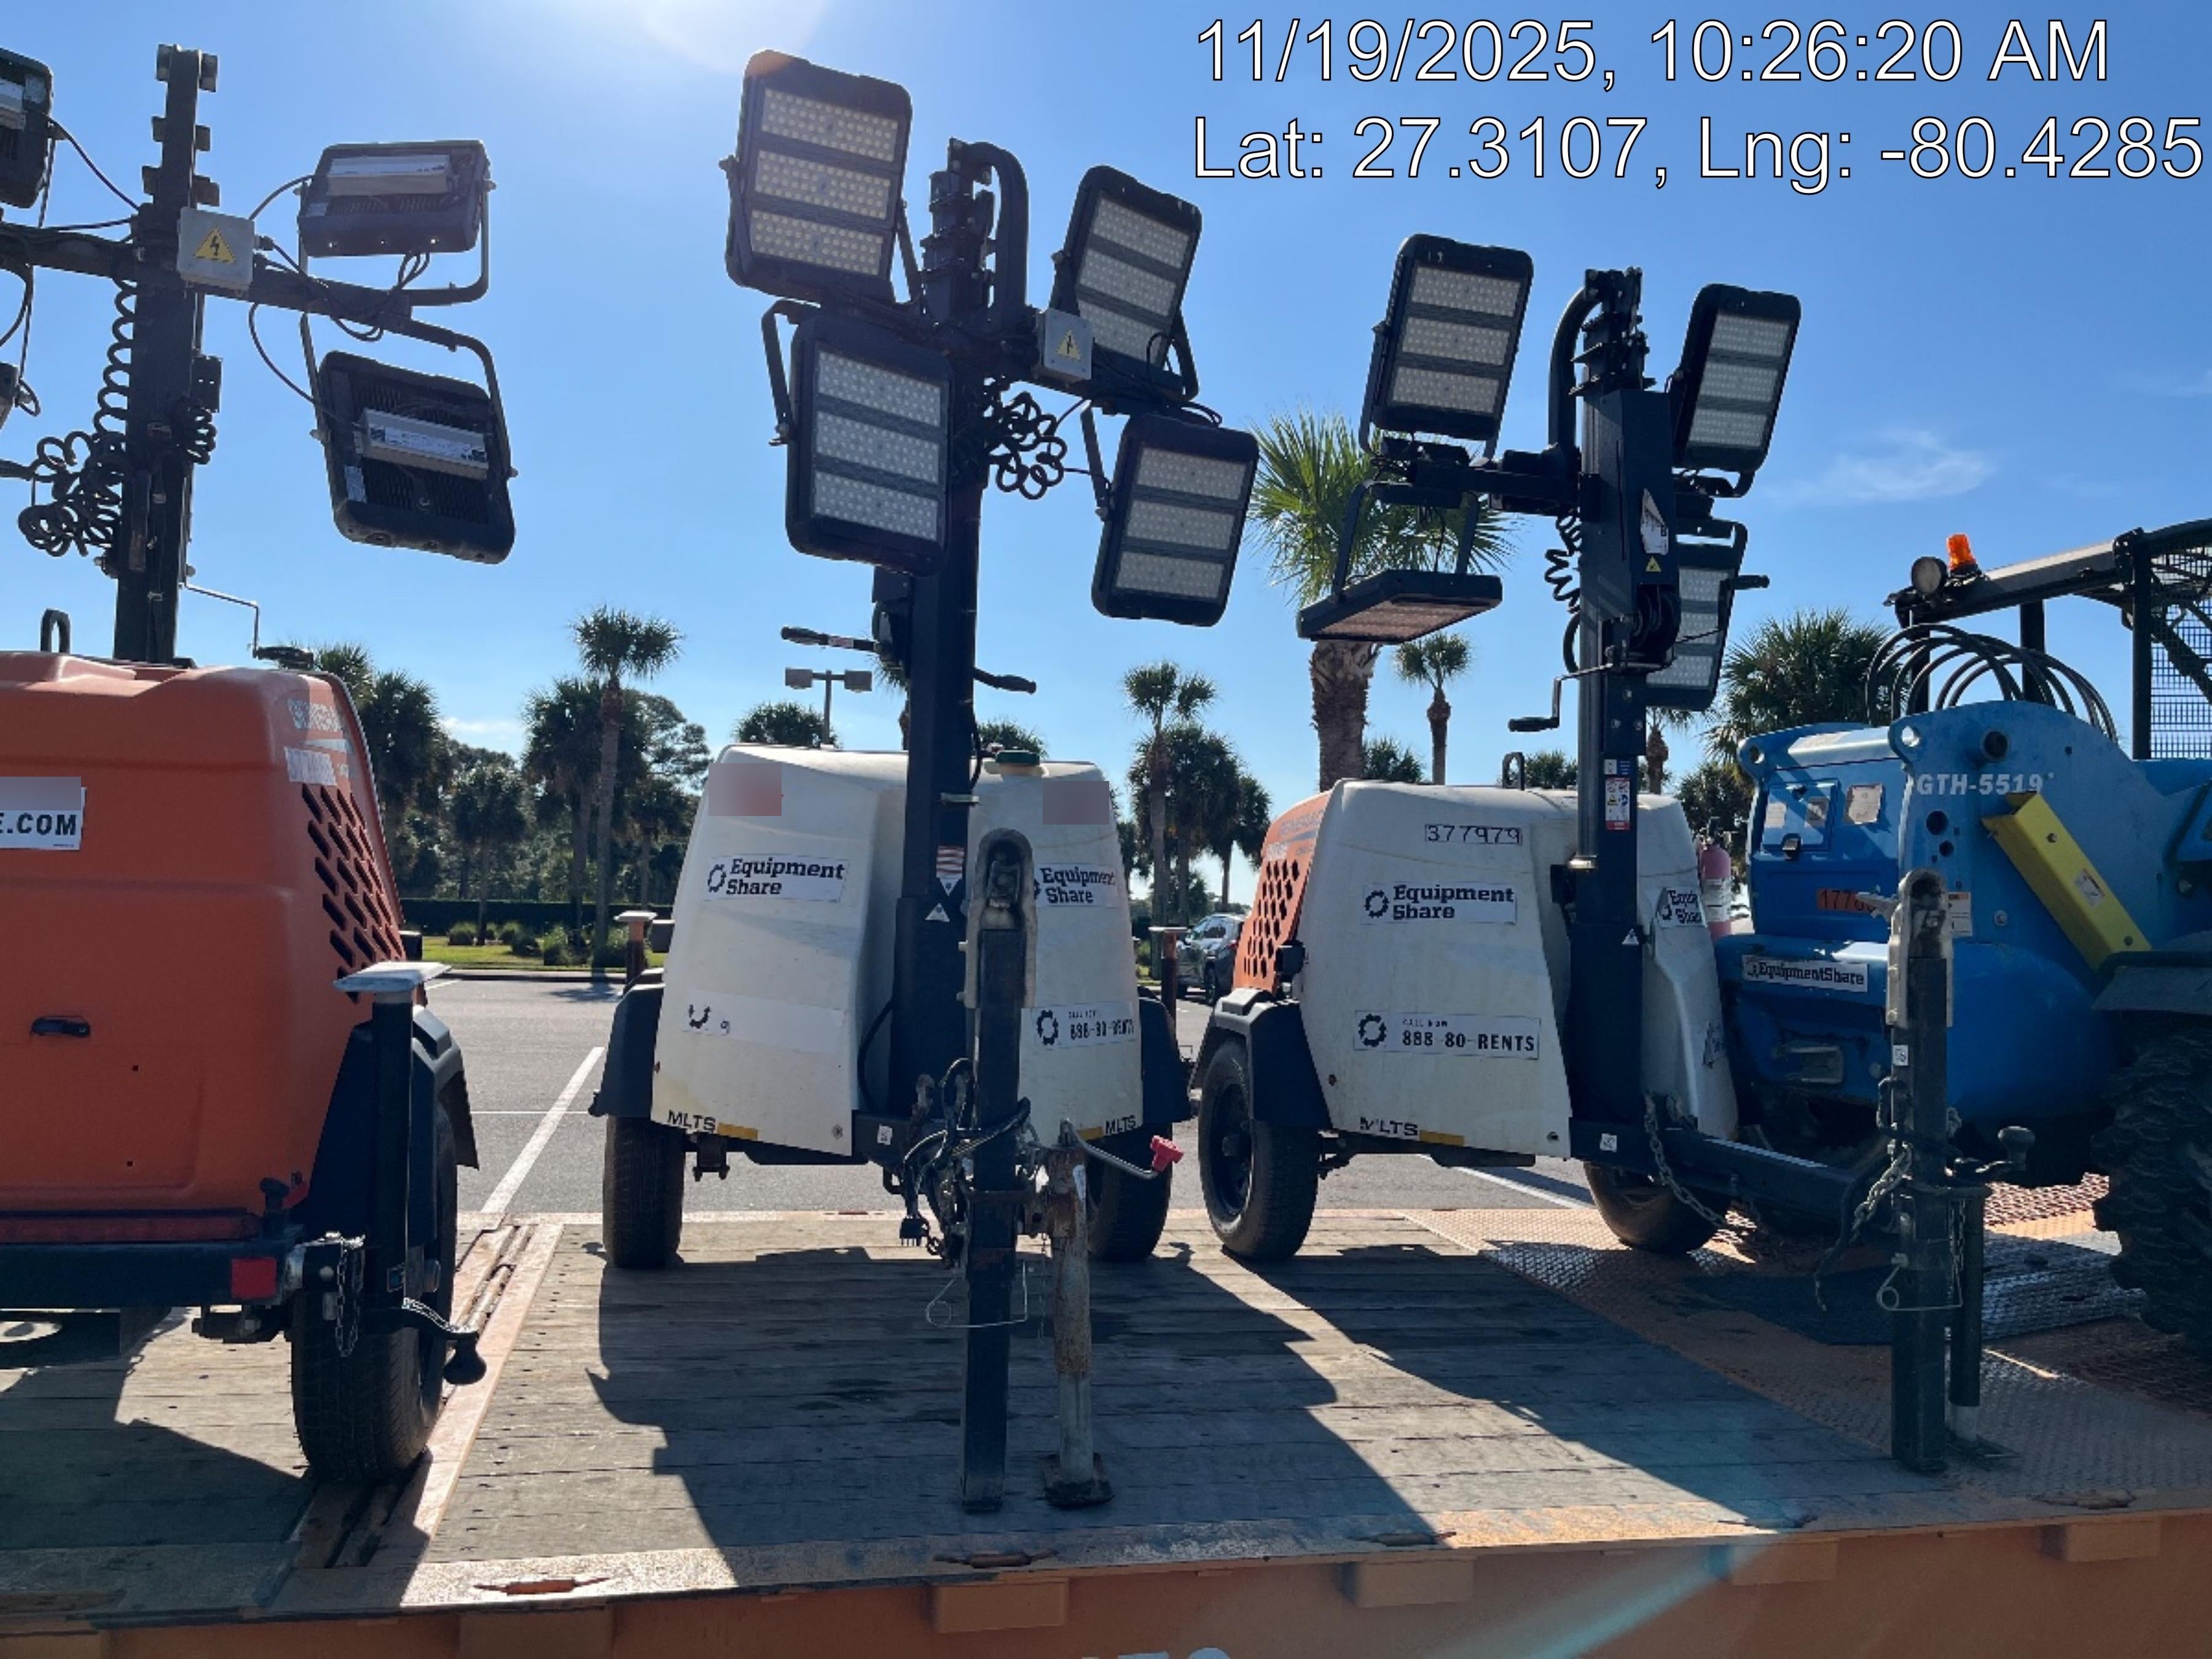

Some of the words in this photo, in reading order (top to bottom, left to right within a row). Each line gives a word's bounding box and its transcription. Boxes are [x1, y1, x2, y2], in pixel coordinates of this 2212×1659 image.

[1916, 774, 2044, 795] GTH-5519
[1427, 825, 1520, 845] 377979
[730, 857, 845, 879] Equipment
[726, 878, 782, 895] Share
[1045, 886, 1094, 904] Share
[1392, 884, 1514, 904] Equipment
[1392, 904, 1456, 920] Share
[1758, 962, 1864, 984] EquipmentShare
[1402, 1029, 1535, 1052] 888-80-RENTS
[668, 1109, 716, 1131] MLTS
